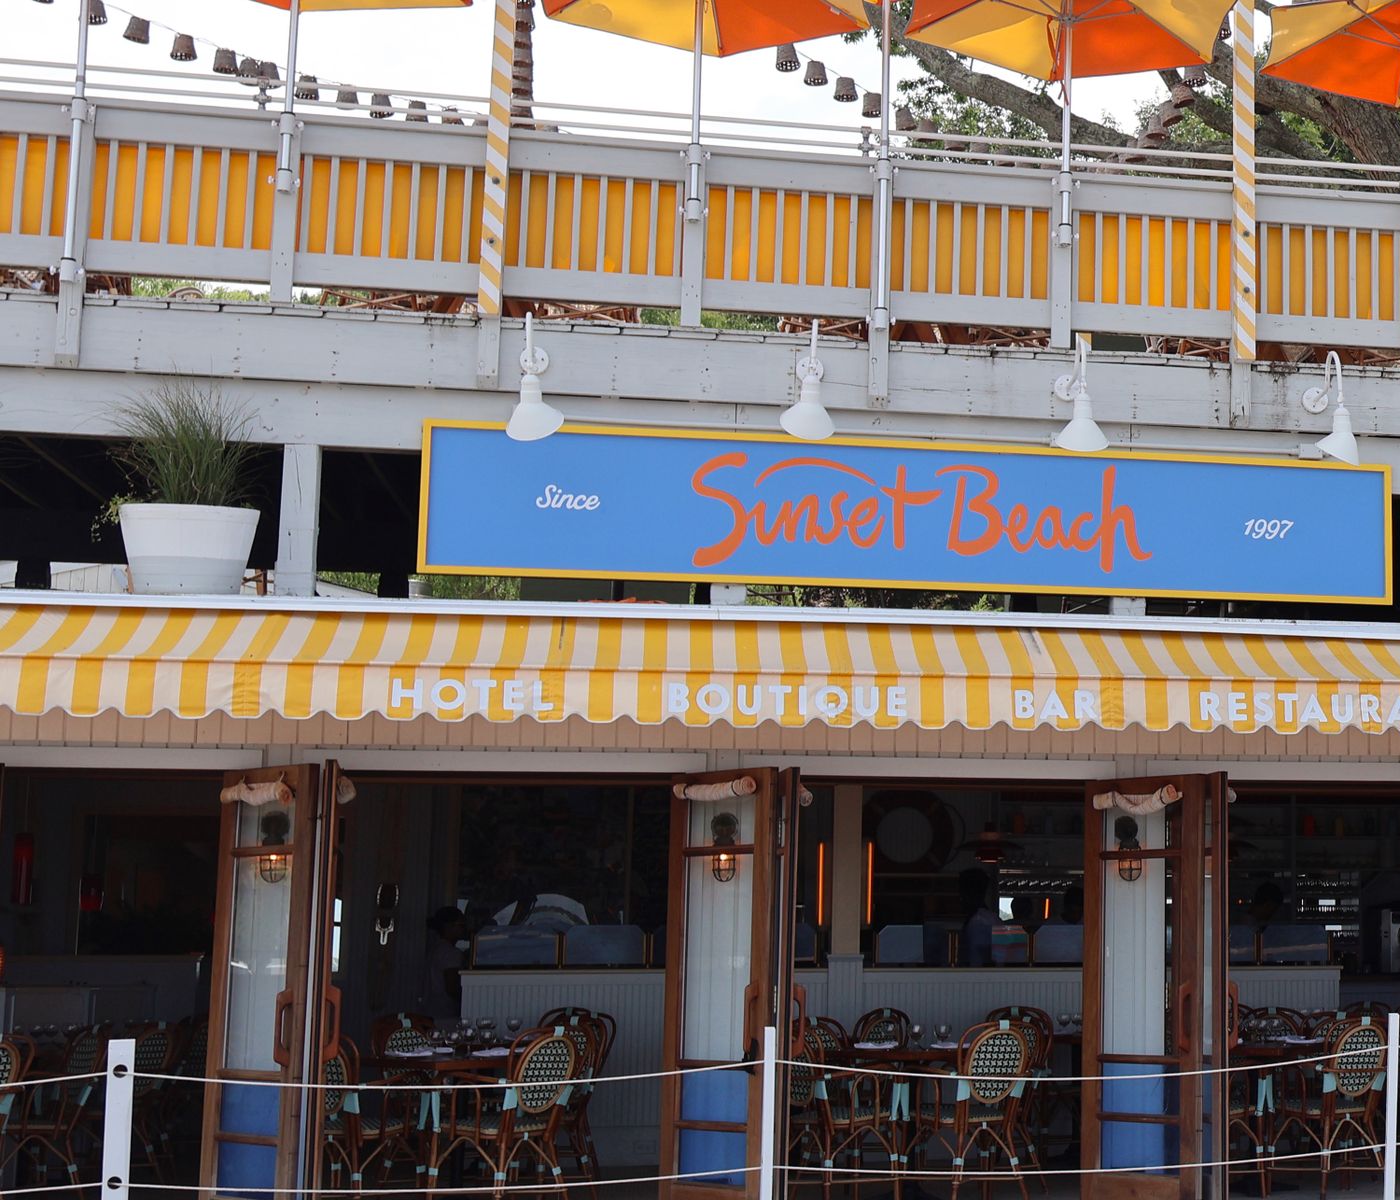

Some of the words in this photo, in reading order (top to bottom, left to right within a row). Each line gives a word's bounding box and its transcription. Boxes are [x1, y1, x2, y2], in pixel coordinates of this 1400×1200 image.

[535, 484, 601, 511] Since
[691, 451, 943, 568] Sunset
[935, 464, 1153, 573] Beach
[1243, 518, 1295, 540] 1997
[390, 678, 555, 712] HOTEL
[668, 683, 908, 719] BOUTIQUE
[1013, 689, 1099, 720] BAR
